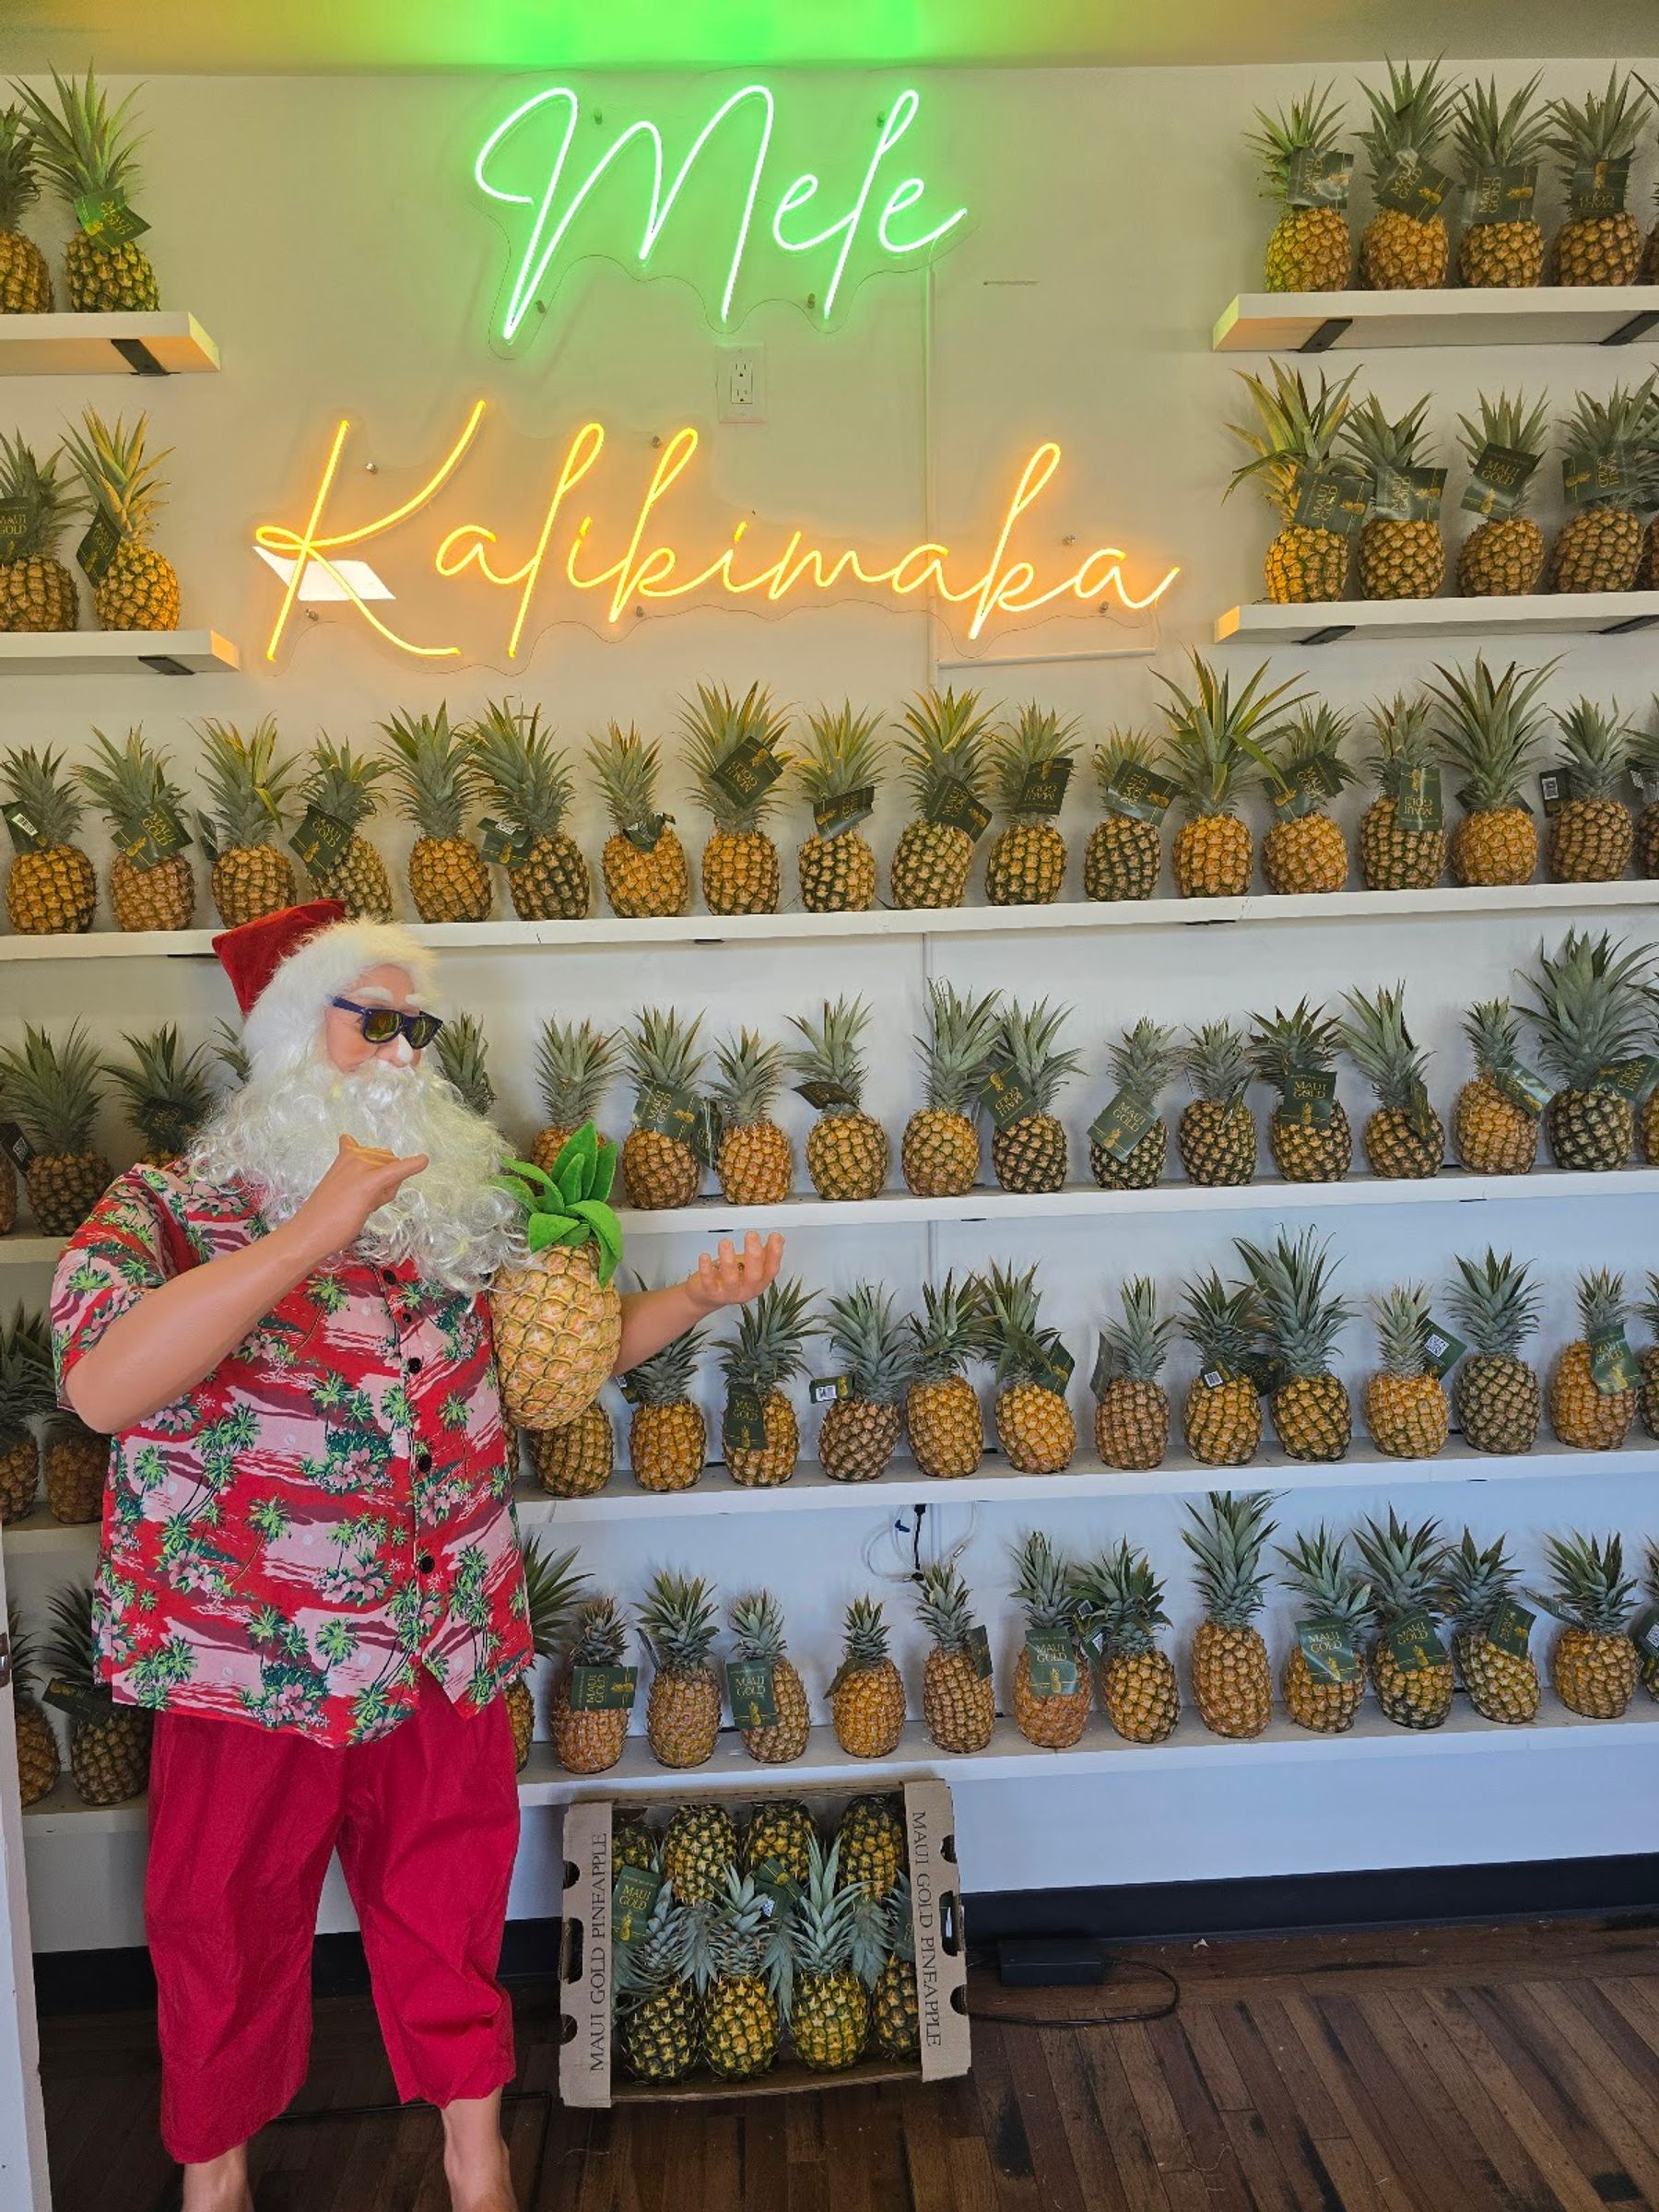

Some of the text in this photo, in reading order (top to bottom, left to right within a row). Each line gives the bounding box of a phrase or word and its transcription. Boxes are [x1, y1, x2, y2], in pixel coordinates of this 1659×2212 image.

[1398, 168, 1423, 200] GOLD
[1478, 176, 1491, 214] MAUI
[1488, 175, 1503, 214] GOLD
[475, 85, 968, 341] Mele
[1481, 469, 1516, 487] GOLD
[1484, 460, 1521, 478] MAUI
[1312, 482, 1330, 518] MAUI
[1392, 476, 1403, 512] MAUI
[1399, 476, 1412, 512] GOLD
[254, 400, 1181, 661] Kalikimaka
[141, 818, 170, 847] GOLD
[147, 812, 177, 842] MAUI
[1293, 1080, 1327, 1091] MAUI
[1112, 1108, 1141, 1133] GOLD
[1119, 1100, 1147, 1126] MAUI
[1036, 1641, 1066, 1653] MAUI
[1308, 1630, 1341, 1644] MAUI
[1310, 1641, 1343, 1653] GOLD
[1036, 1653, 1068, 1663] GOLD
[586, 1675, 597, 1703] MAUI
[595, 1674, 607, 1703] GOLD
[735, 1676, 765, 1688] MAUI
[736, 1686, 766, 1697] GOLD
[618, 1896, 647, 1911] GOLD
[621, 1885, 652, 1901] MAUI
[912, 1811, 941, 2047] MAUI GOLD PINEAPPLE
[590, 1832, 607, 2073] MAUI GOLD PINEAPPLE
